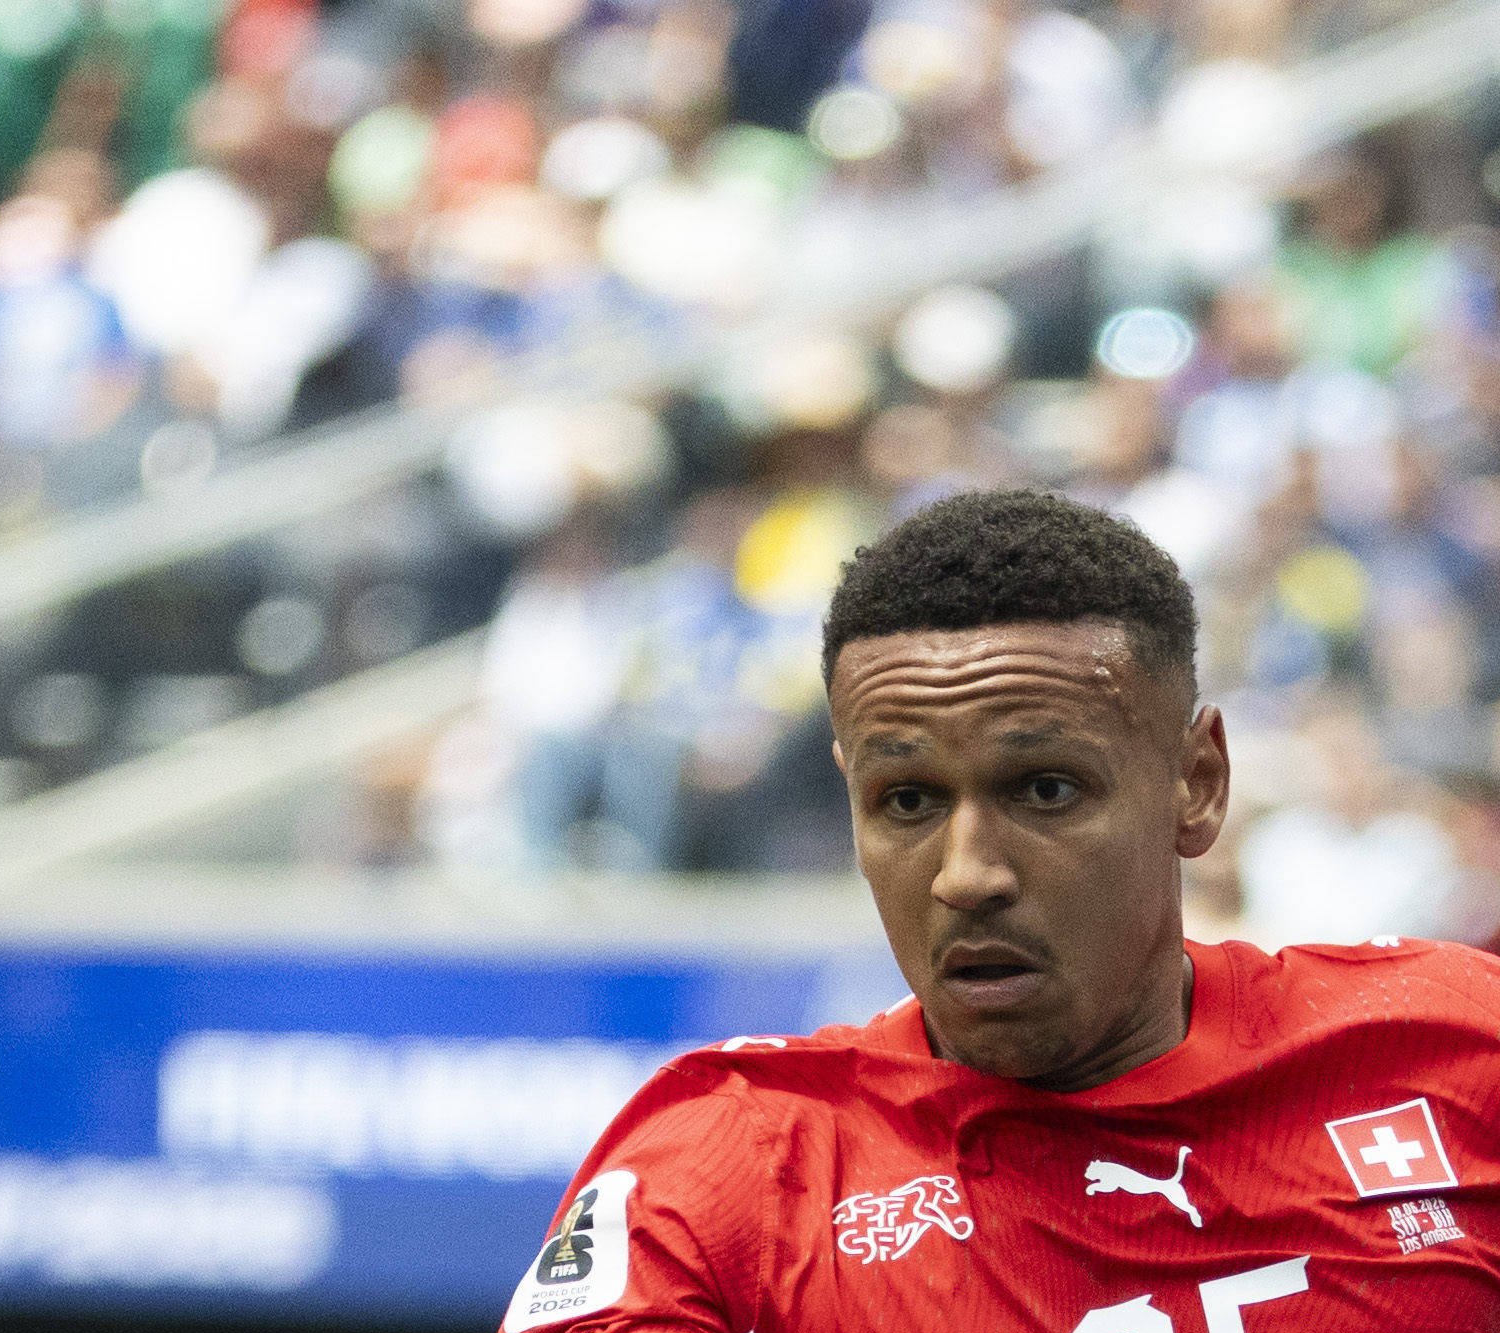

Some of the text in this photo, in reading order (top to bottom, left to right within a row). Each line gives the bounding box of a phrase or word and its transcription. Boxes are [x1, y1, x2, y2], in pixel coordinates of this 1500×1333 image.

[1392, 1215, 1421, 1240] SUI
[1398, 1236, 1422, 1256] LOS
[550, 1263, 579, 1279] FIFA
[571, 1285, 591, 1296] CUP
[528, 1295, 587, 1315] 2026
